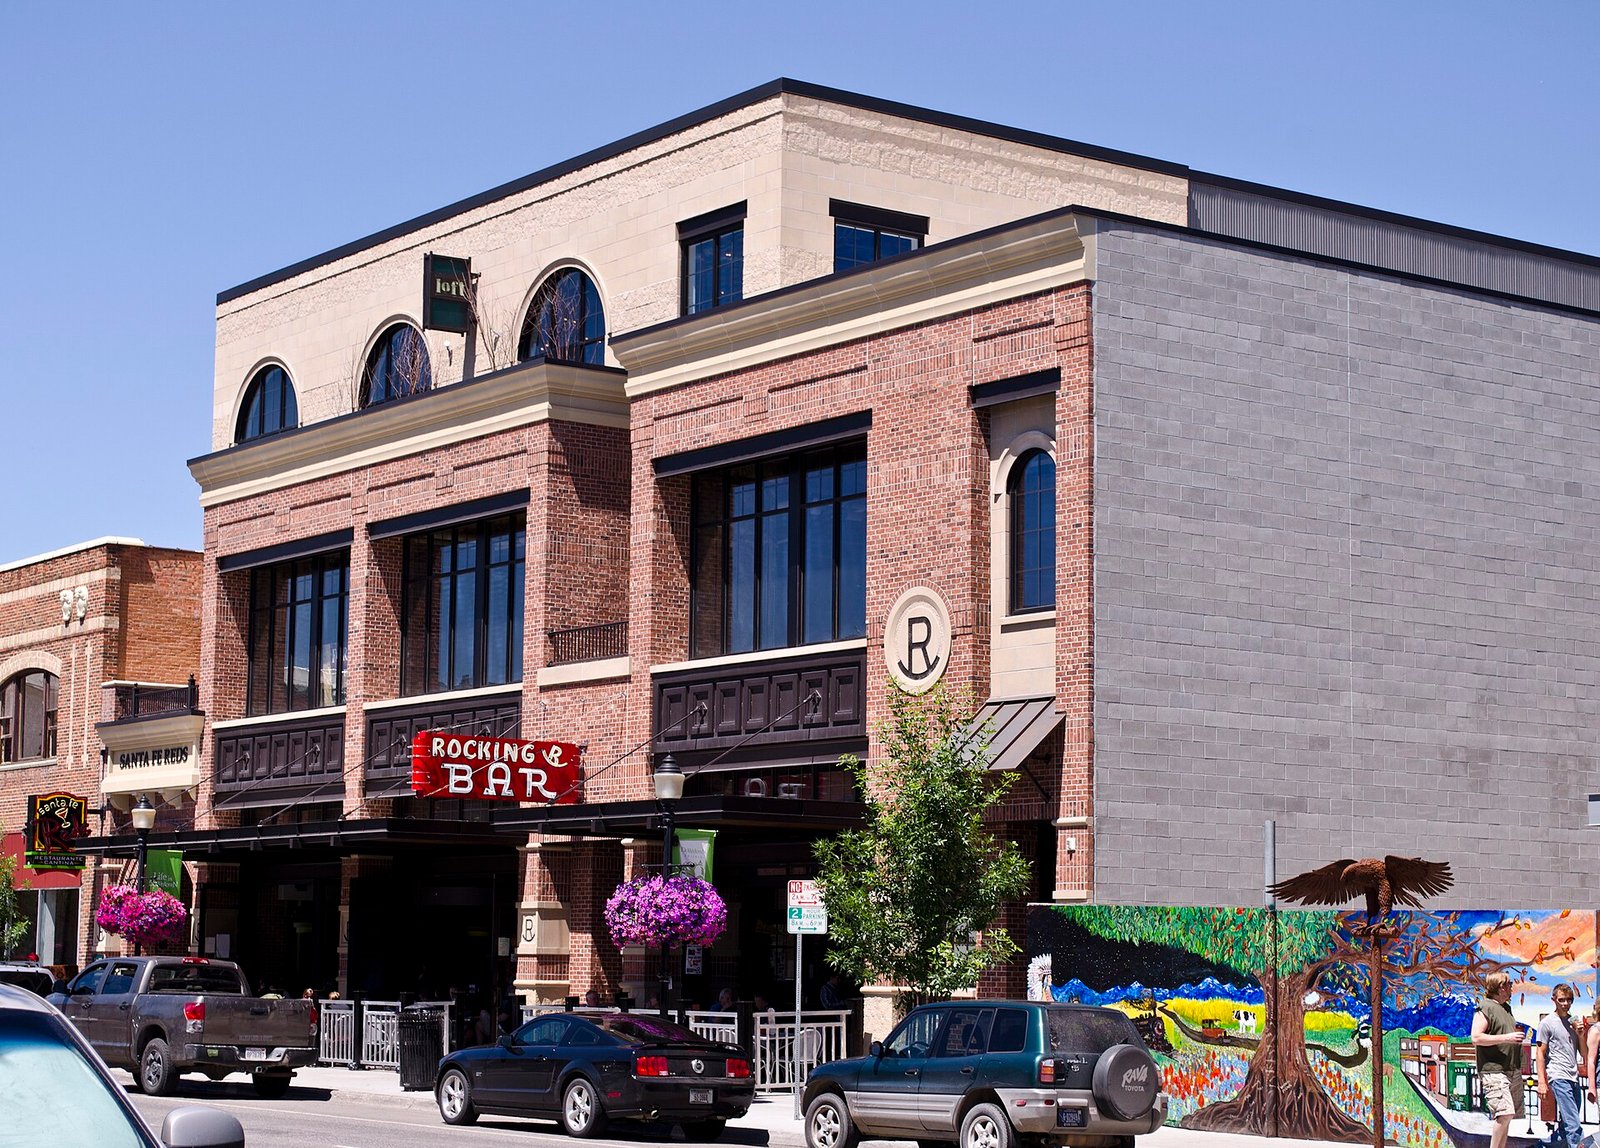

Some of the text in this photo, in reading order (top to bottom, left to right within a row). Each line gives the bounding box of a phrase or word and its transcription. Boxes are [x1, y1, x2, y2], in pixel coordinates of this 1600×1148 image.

[435, 278, 465, 297] loft
[897, 615, 940, 681] R
[119, 746, 188, 770] SANTA FE REDS
[432, 737, 535, 763] ROCKING
[440, 762, 557, 799] BAR
[38, 798, 67, 816] santa
[790, 882, 801, 892] NO
[791, 908, 799, 919] 2
[1121, 1064, 1148, 1088] RAV4
